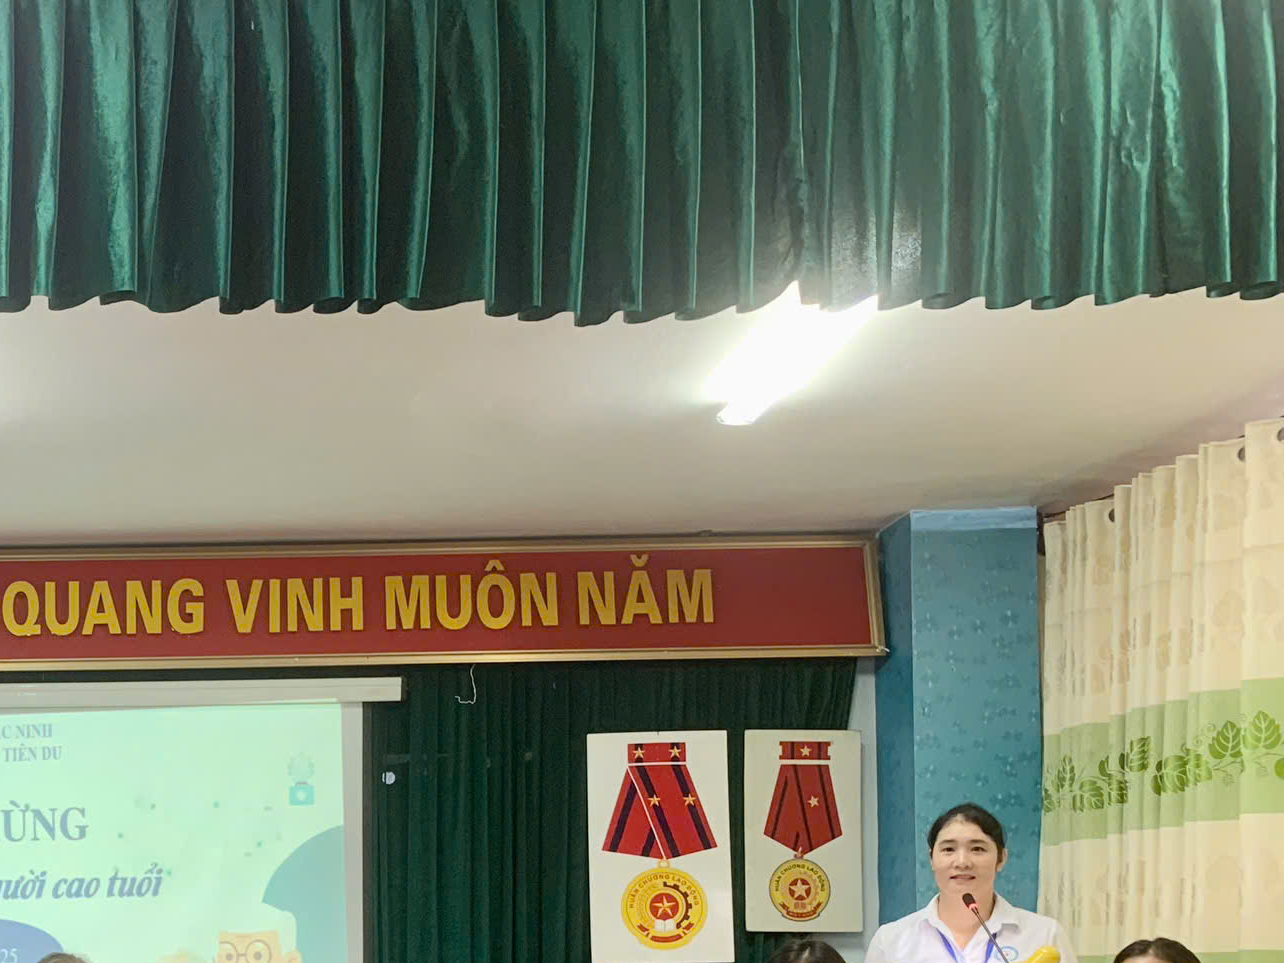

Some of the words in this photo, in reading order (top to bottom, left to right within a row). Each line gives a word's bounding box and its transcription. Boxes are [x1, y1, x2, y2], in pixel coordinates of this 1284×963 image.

[1, 579, 205, 638] QUANG
[227, 575, 365, 633] VINH
[384, 561, 559, 631] MUÔN
[576, 554, 714, 626] NĂM
[14, 723, 53, 739] NINH
[41, 745, 63, 761] DU
[51, 876, 101, 900] cao
[106, 861, 164, 898] tuổi
